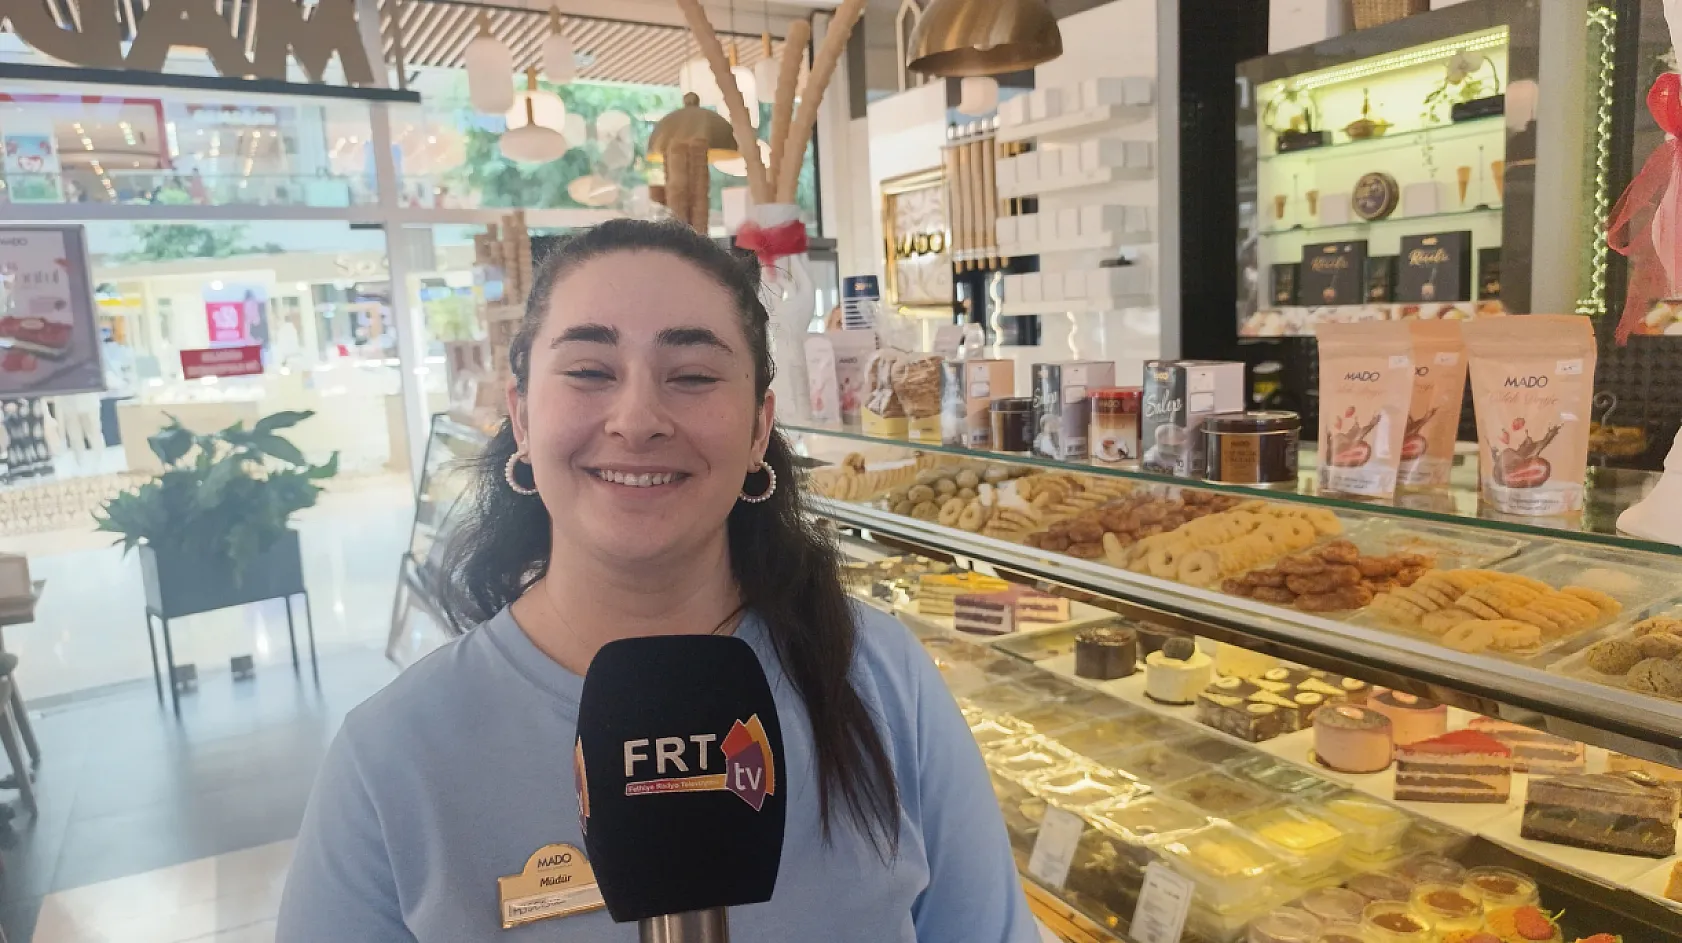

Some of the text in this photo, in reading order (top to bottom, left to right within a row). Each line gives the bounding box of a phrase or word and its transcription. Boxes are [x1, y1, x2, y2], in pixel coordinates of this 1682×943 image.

[1344, 371, 1380, 382] MADO
[1504, 375, 1548, 388] MADO
[1146, 388, 1182, 421] Salep
[623, 734, 716, 777] FRT
[734, 762, 762, 790] tv
[655, 782, 680, 790] Radyo
[537, 853, 572, 868] MADO
[540, 873, 573, 887] Müdür
